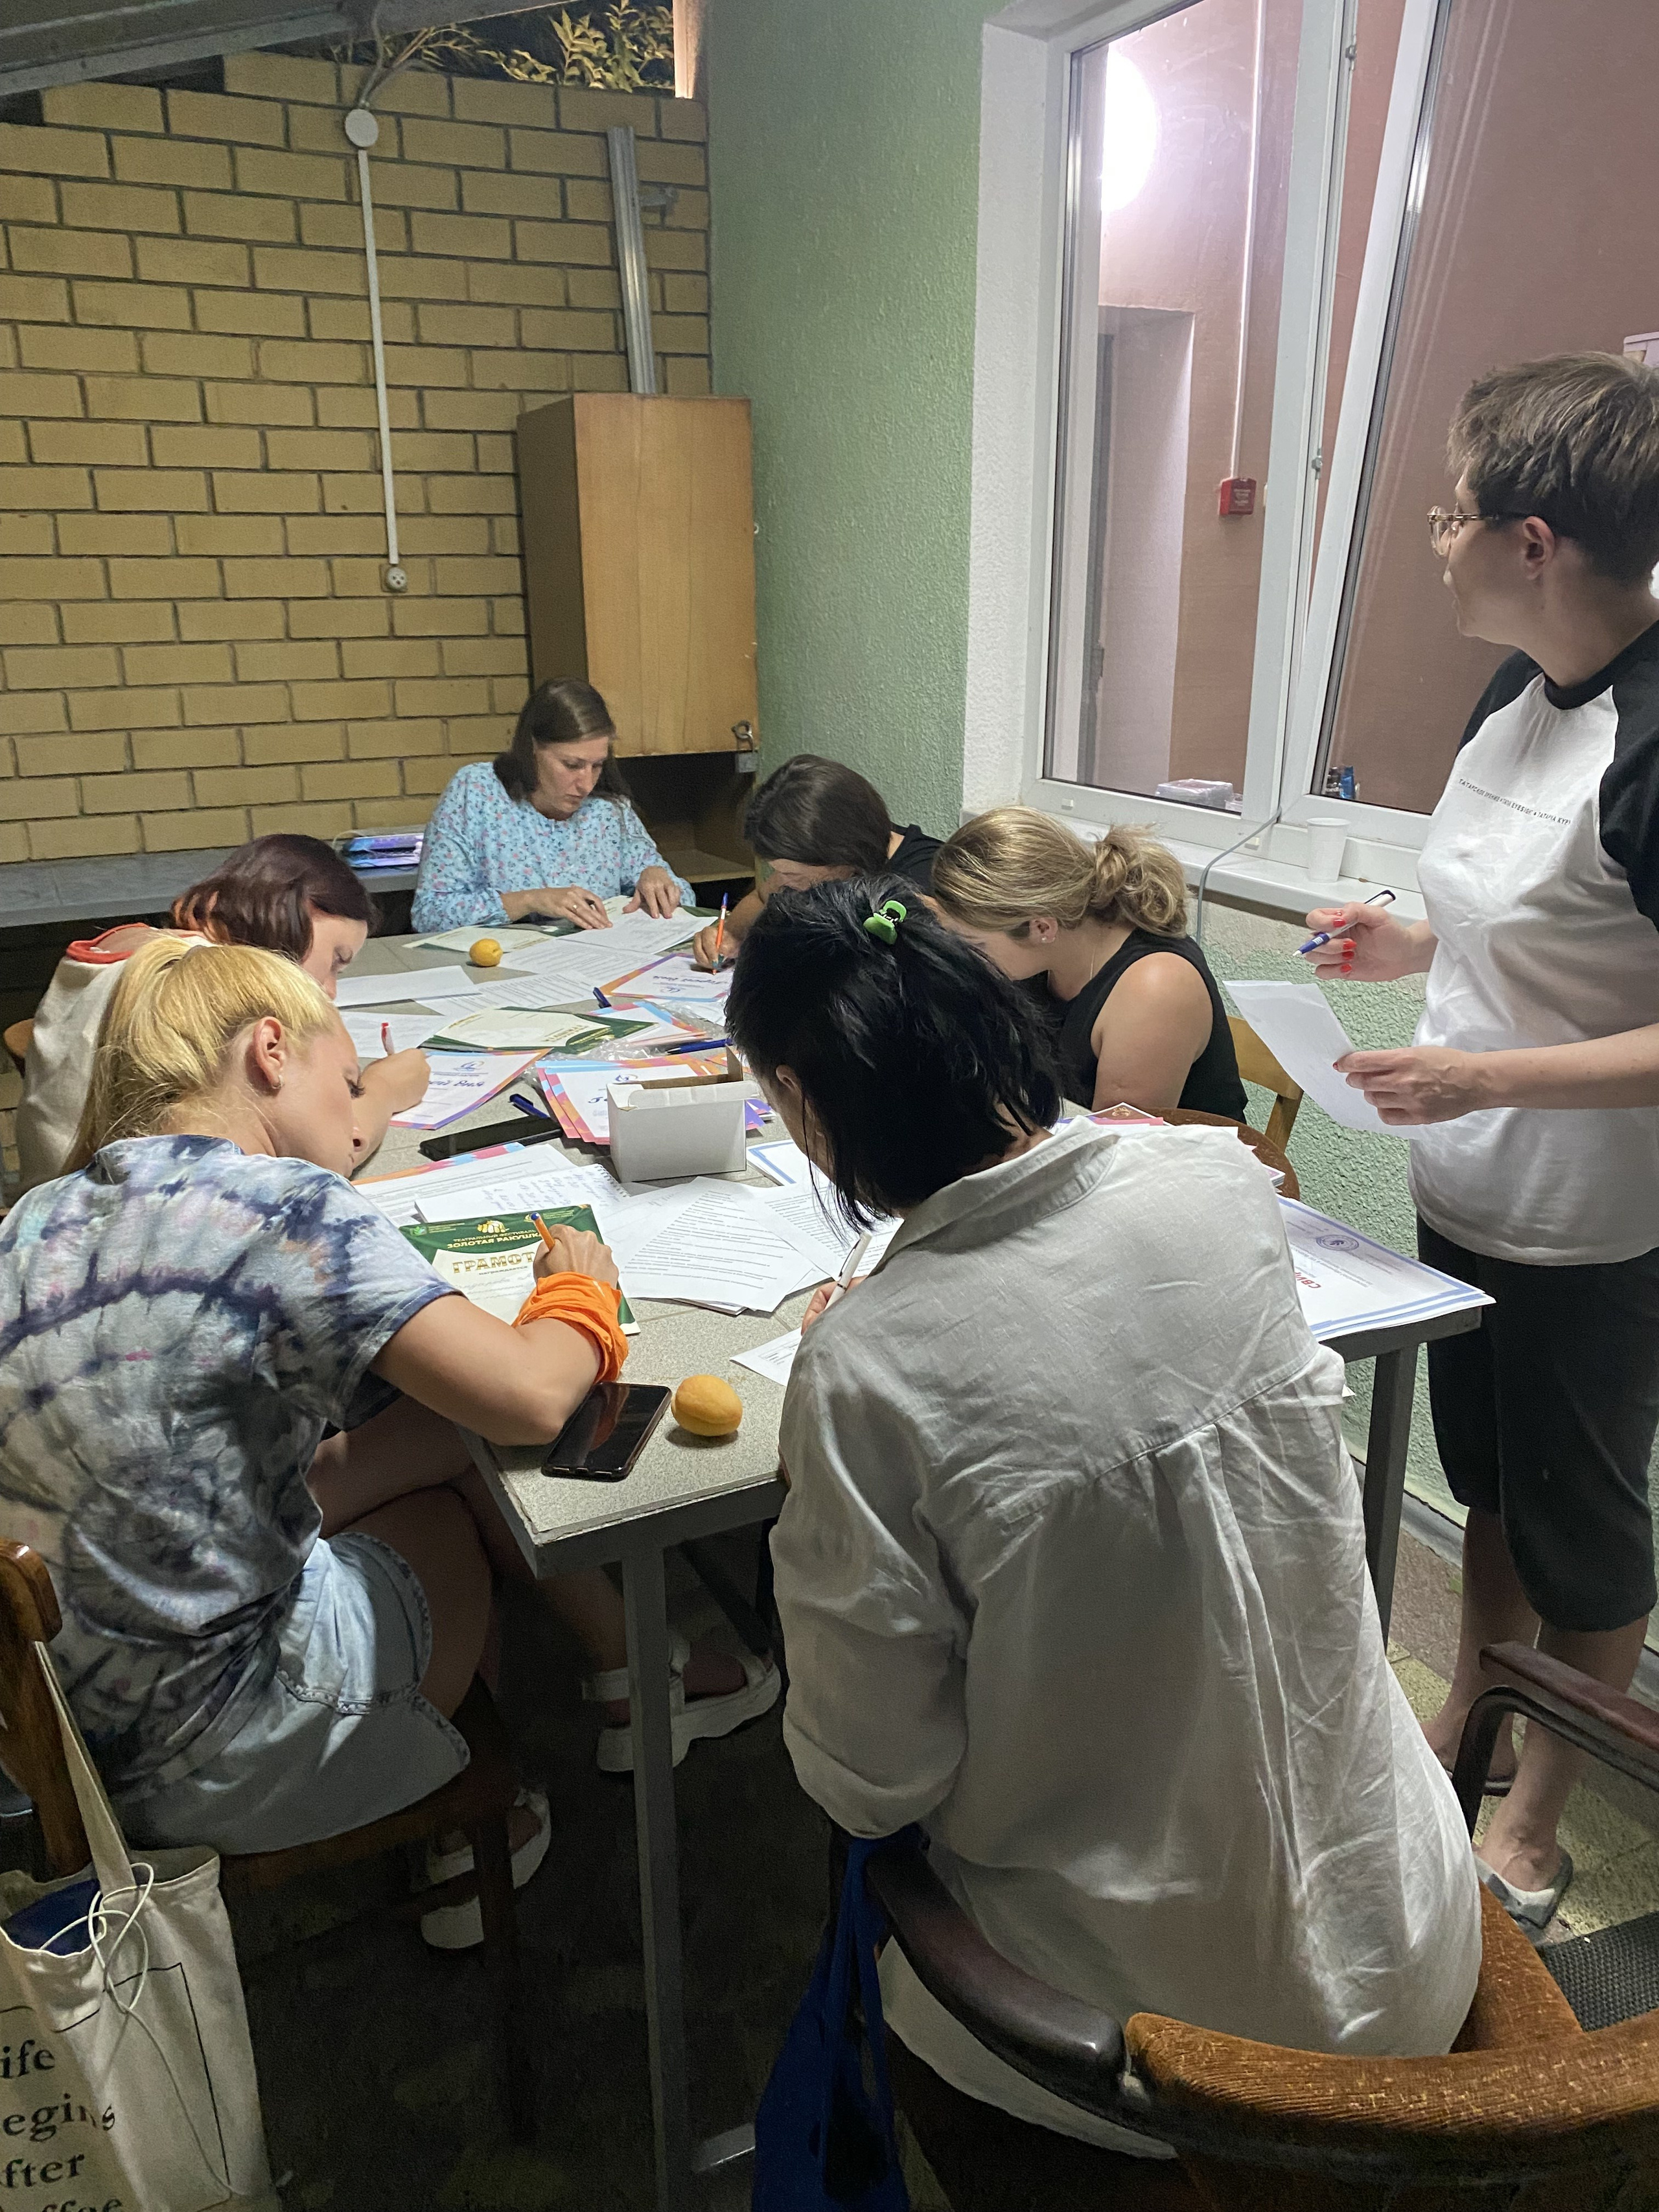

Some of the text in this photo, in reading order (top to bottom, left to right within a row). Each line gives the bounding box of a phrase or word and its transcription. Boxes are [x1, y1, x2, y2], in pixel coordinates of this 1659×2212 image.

[447, 1238, 495, 1249] ЗОЛОТАЯ
[452, 1252, 536, 1274] ГРАМОТ
[0, 2040, 56, 2079] ife
[0, 2154, 86, 2189] fter
